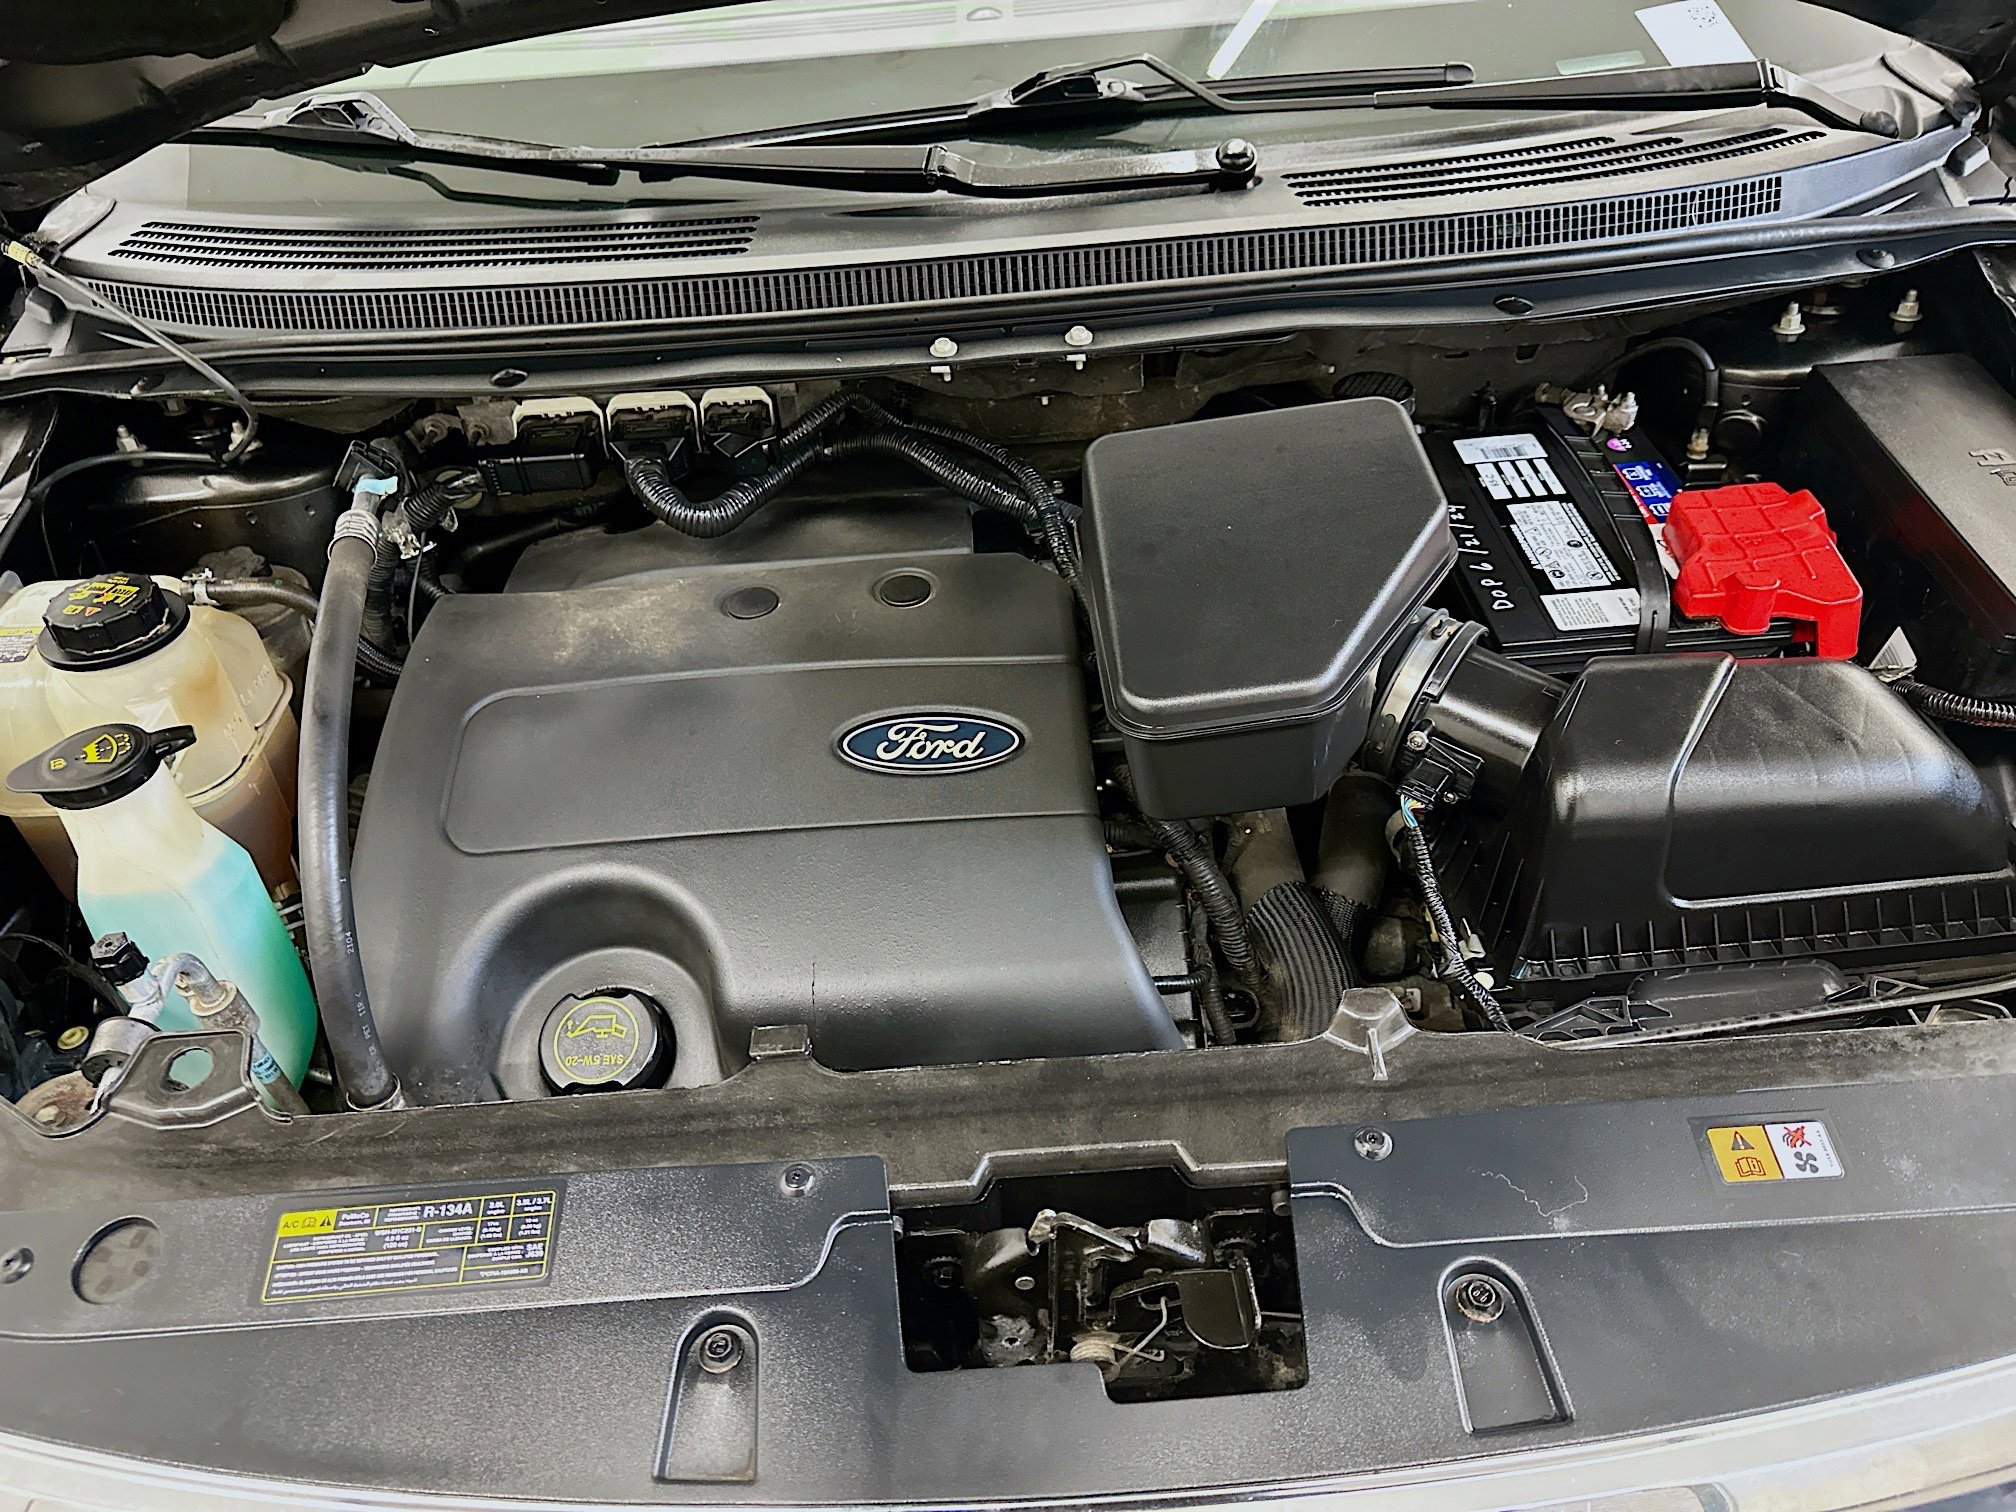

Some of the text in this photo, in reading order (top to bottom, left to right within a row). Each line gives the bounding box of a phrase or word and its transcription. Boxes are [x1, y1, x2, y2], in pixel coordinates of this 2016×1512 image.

[876, 722, 987, 761] Ford
[345, 931, 355, 954] 2104
[566, 1054, 624, 1066] SAE 5W-20
[423, 1202, 473, 1218] R-134A
[283, 1220, 300, 1229] A/C
